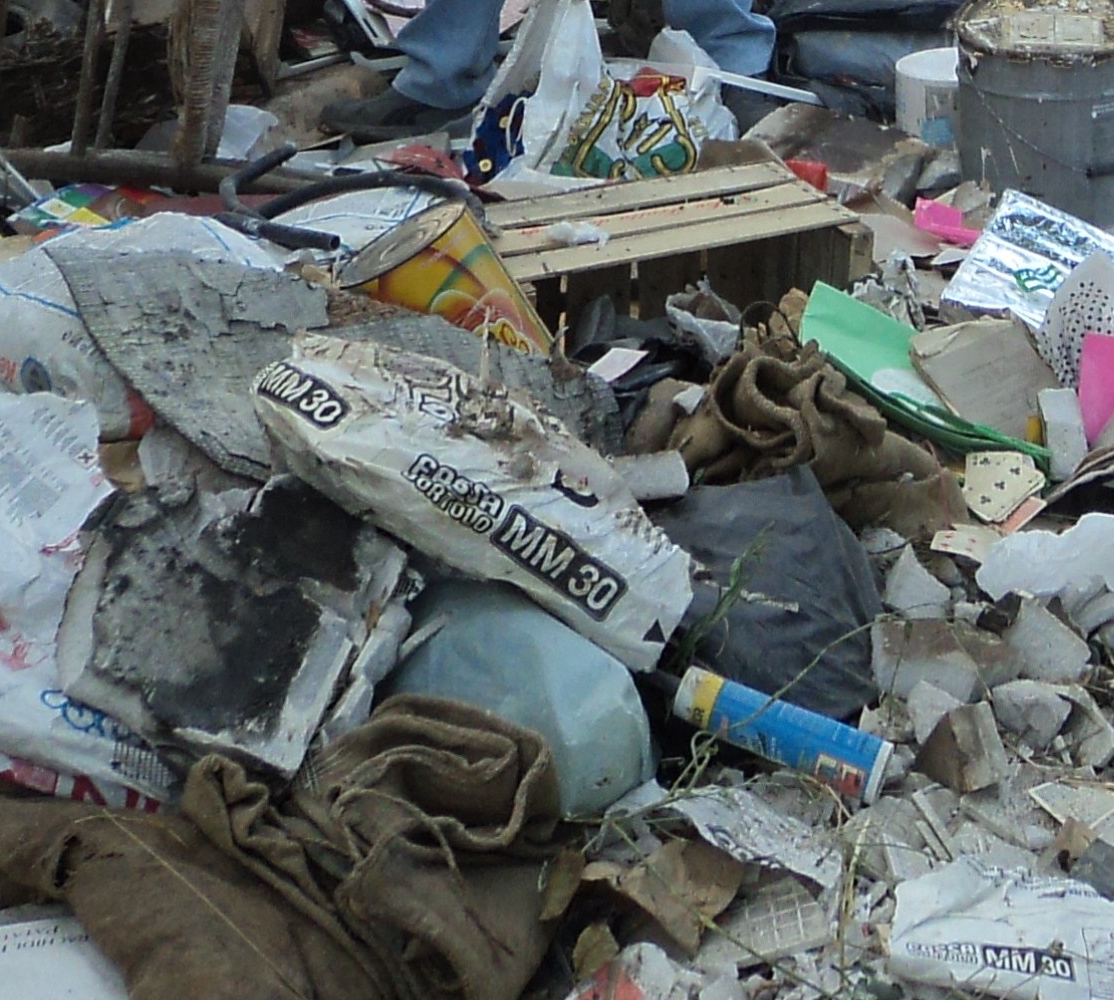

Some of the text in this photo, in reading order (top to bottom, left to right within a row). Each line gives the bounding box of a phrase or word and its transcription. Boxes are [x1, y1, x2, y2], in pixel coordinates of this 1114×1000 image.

[260, 365, 313, 402] MM
[299, 389, 342, 422] 30
[402, 471, 494, 534] ORTOLO
[500, 513, 619, 612] MM 30
[985, 948, 1072, 977] MM 30
